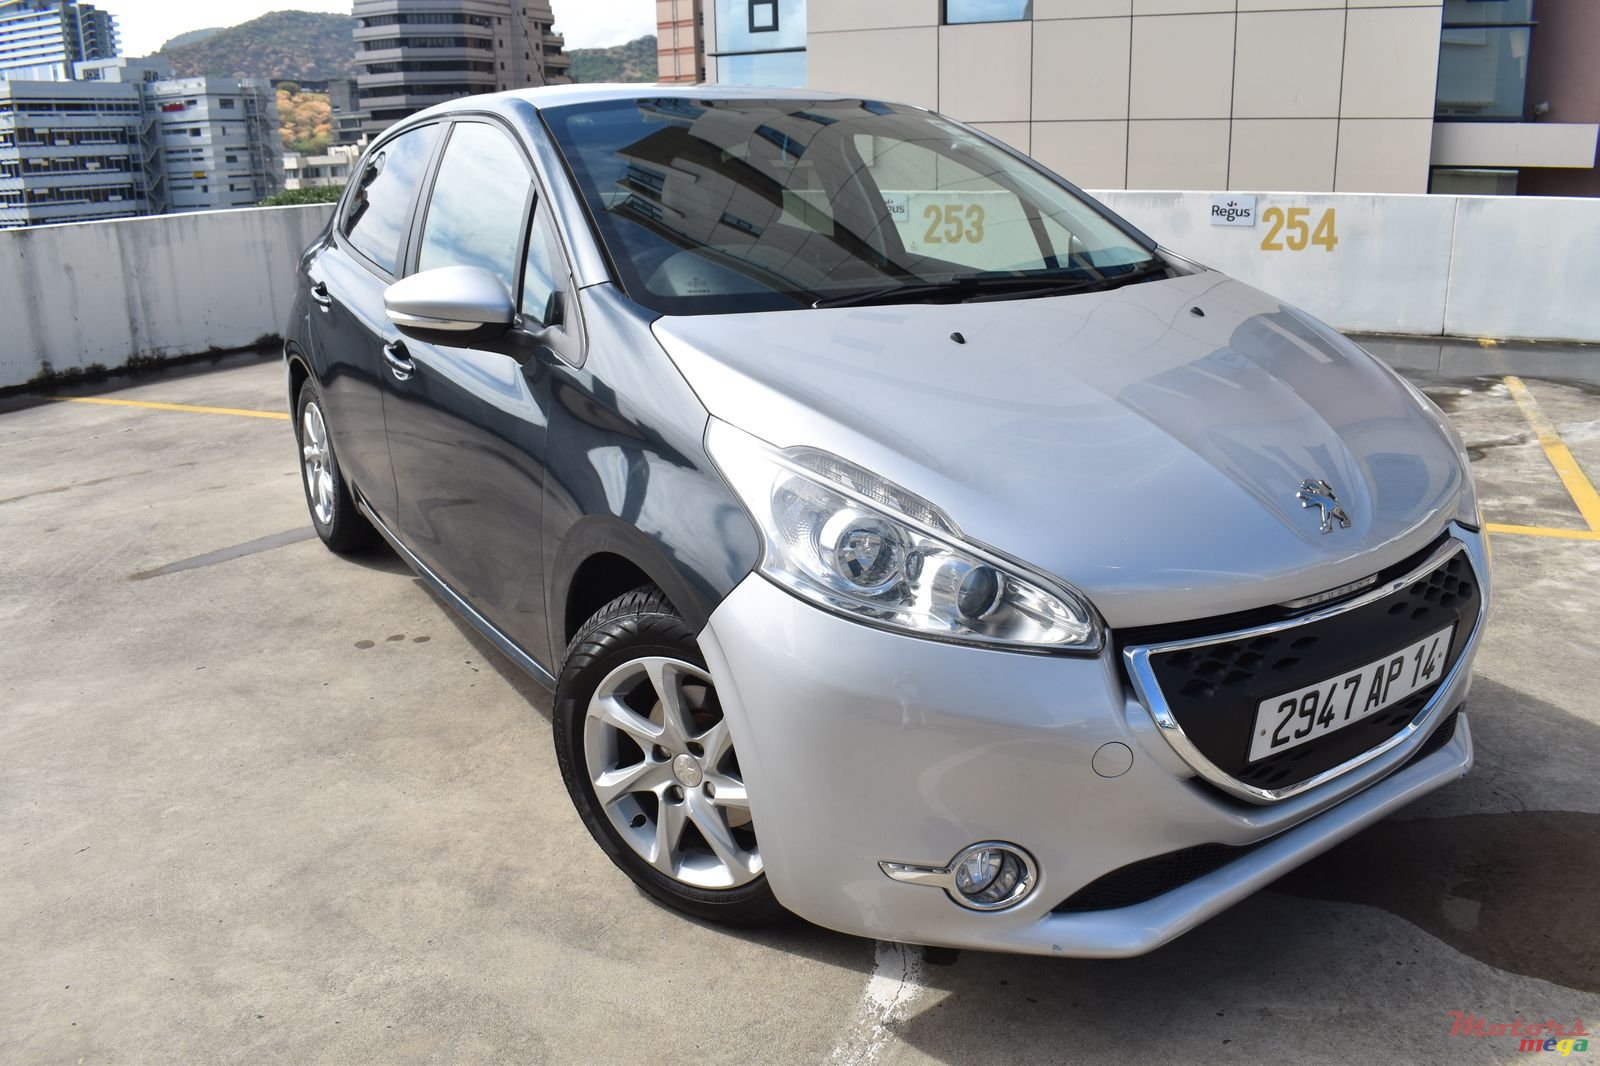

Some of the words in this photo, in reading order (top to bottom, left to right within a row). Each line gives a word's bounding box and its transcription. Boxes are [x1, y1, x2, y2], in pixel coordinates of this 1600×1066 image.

[924, 204, 985, 244] 253
[1211, 203, 1251, 221] Regus
[1261, 207, 1338, 252] 254
[1270, 673, 1362, 749] 2947
[1364, 656, 1404, 713] AP
[1411, 637, 1440, 689] 14
